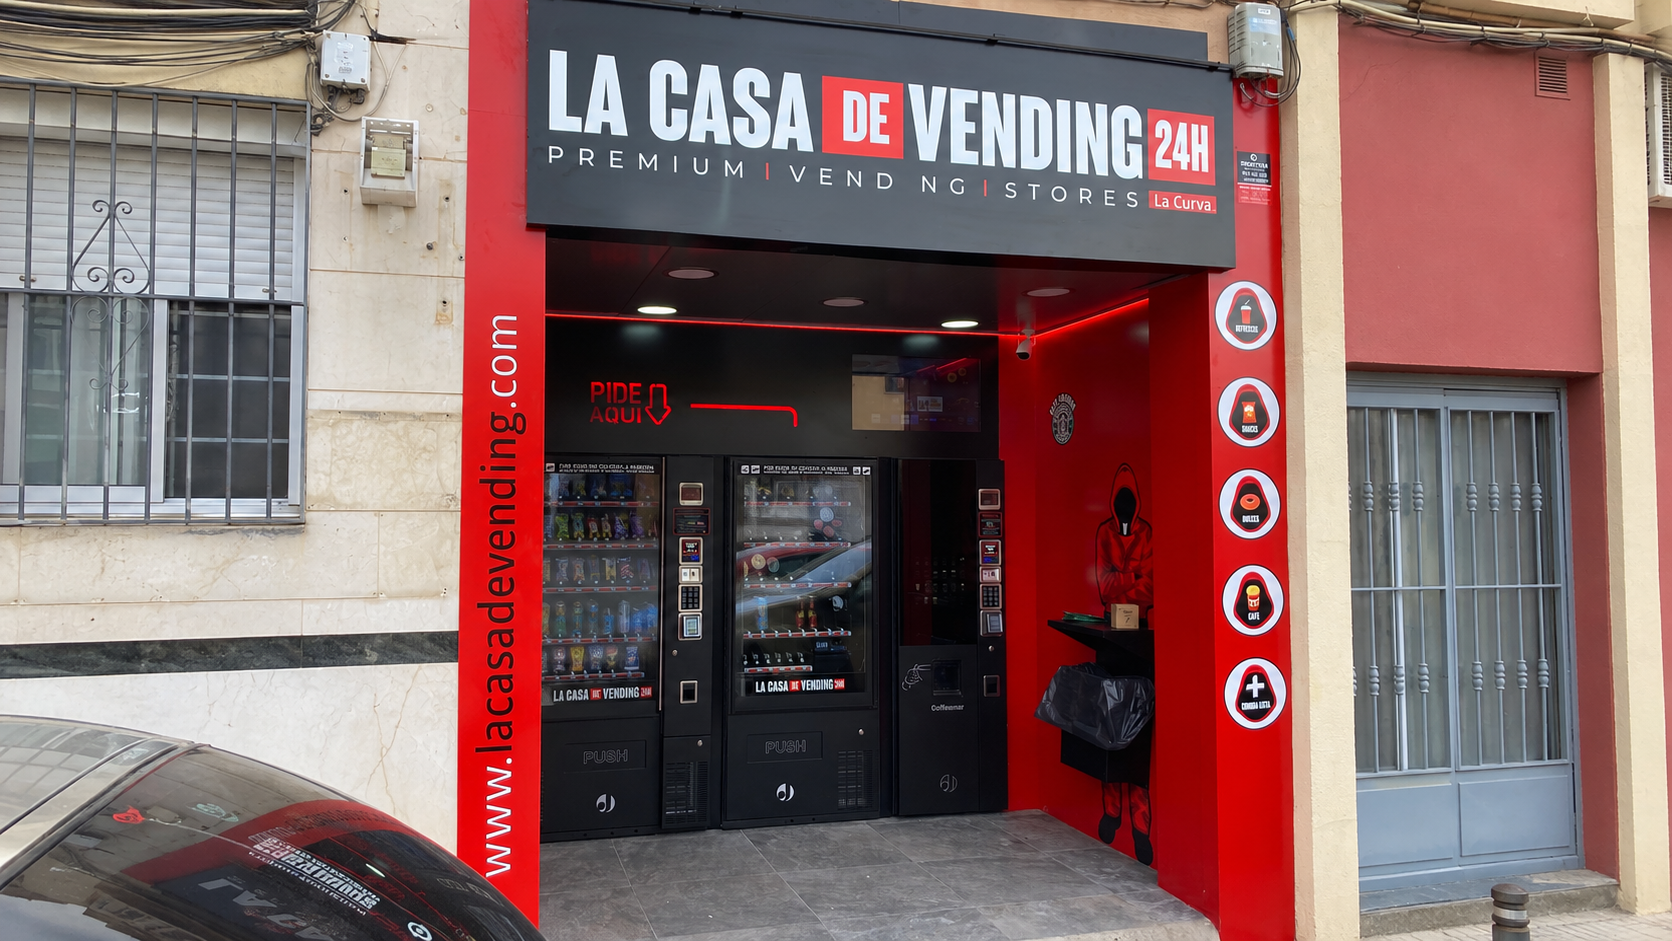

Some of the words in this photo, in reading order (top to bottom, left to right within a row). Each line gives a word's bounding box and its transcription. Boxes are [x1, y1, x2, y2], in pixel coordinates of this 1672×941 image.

[548, 49, 629, 137] LA
[649, 59, 815, 153] CASA
[842, 89, 891, 145] DE
[907, 83, 1144, 180] VENDING
[1154, 119, 1210, 173] 24H
[548, 145, 744, 178] PREMIUM
[789, 165, 966, 195] VENDNG
[1004, 182, 1139, 208] STORES
[1154, 193, 1170, 208] La
[1173, 195, 1212, 212] Curva
[590, 381, 642, 404] PIDE
[590, 406, 642, 425] AQUI
[474, 314, 527, 877] www.lacasadevending.com
[553, 690, 565, 702] LA
[566, 689, 589, 702] CASA
[602, 686, 640, 700] VENDING
[755, 681, 766, 693] LA
[767, 681, 789, 692] CASA
[800, 679, 834, 691] VENDING
[765, 739, 807, 754] PUSH
[583, 748, 629, 765] PUSH
